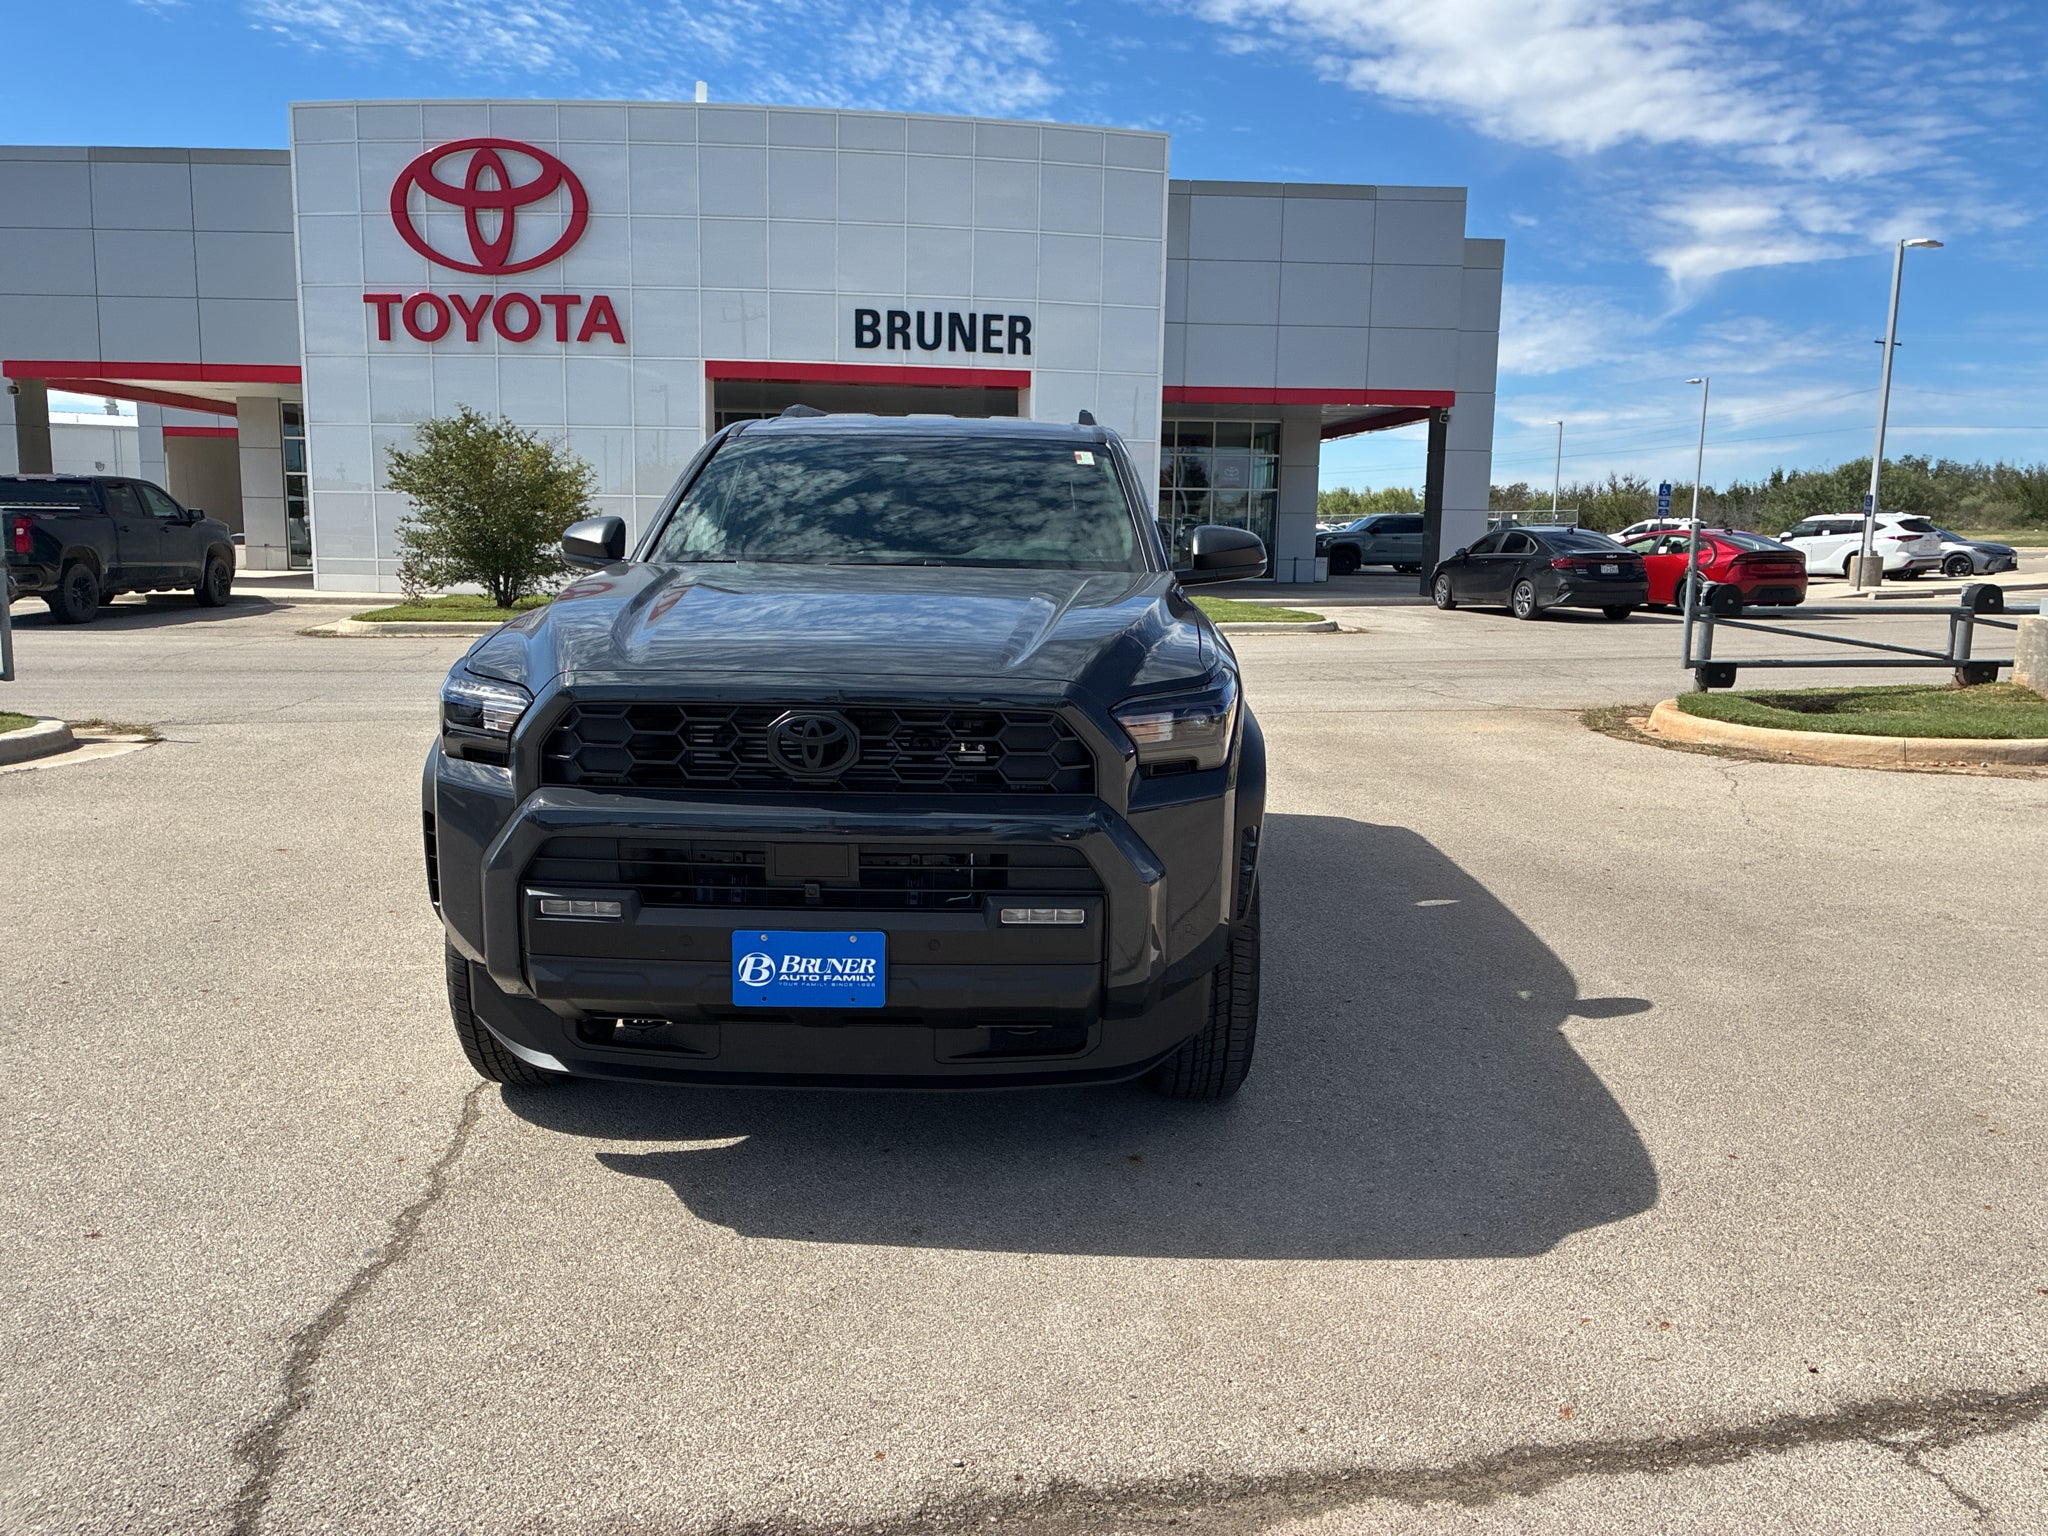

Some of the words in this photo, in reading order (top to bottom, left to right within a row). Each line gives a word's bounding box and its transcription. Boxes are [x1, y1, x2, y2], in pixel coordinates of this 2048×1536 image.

[363, 292, 626, 344] TOYOTA
[855, 309, 1032, 356] BRUNER
[779, 955, 877, 974] BRUNER
[779, 974, 820, 982] AUTO
[823, 974, 876, 982] FAMILY
